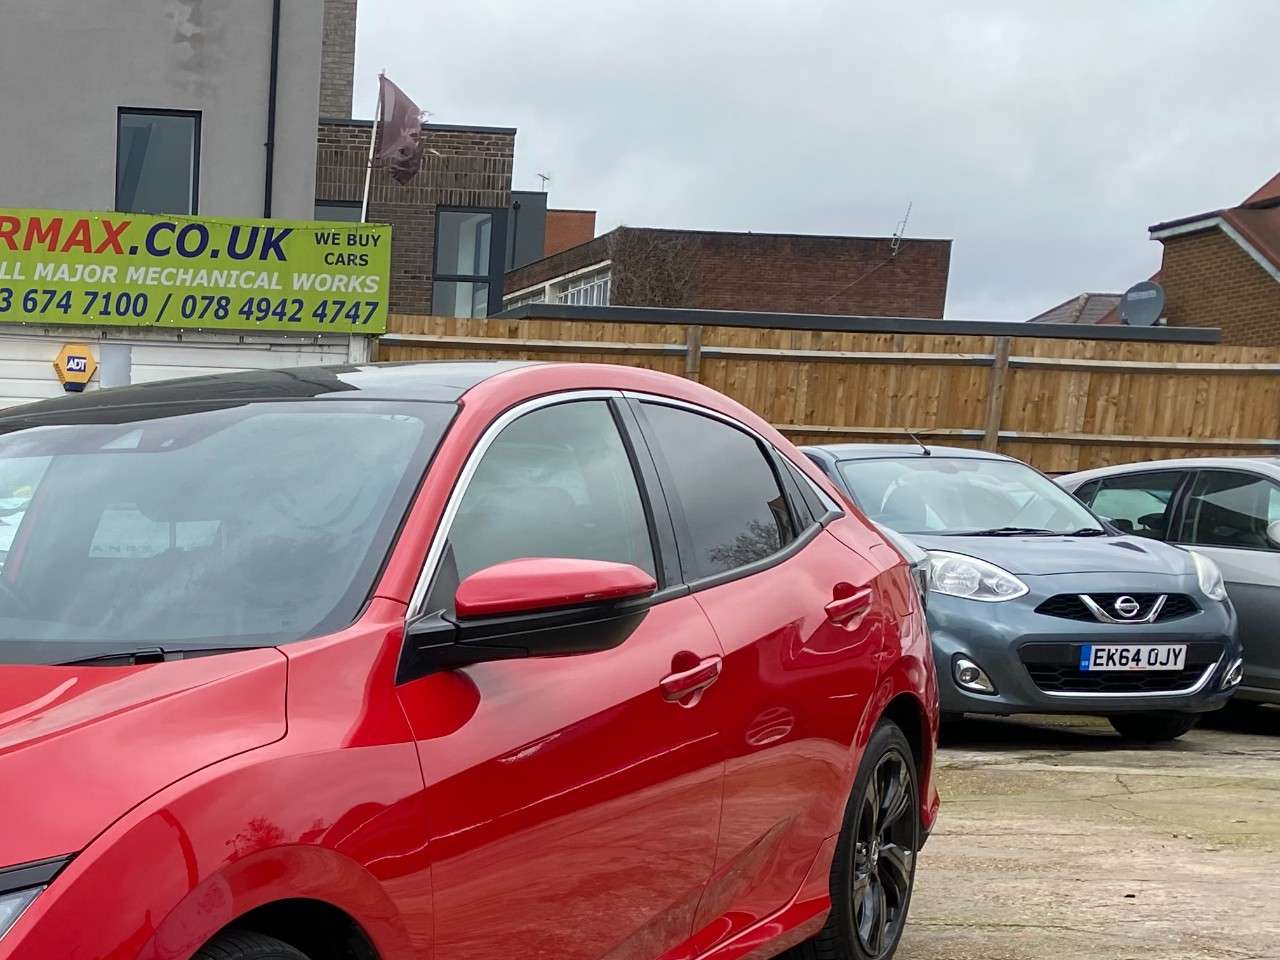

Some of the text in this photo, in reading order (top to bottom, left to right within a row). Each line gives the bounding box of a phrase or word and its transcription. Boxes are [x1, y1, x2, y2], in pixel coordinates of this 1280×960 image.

[314, 232, 381, 248] WE BUY
[324, 252, 369, 267] CARS
[33, 263, 118, 284] MAJOR
[125, 266, 282, 290] MECHANICAL
[292, 273, 380, 293] WORKS
[22, 289, 72, 315] 674
[81, 291, 148, 317] 7100
[180, 295, 231, 321] 078
[239, 297, 304, 324] 4942
[311, 300, 379, 325] 4747
[67, 358, 87, 370] ADT
[1093, 647, 1183, 667] EK64 OJY
